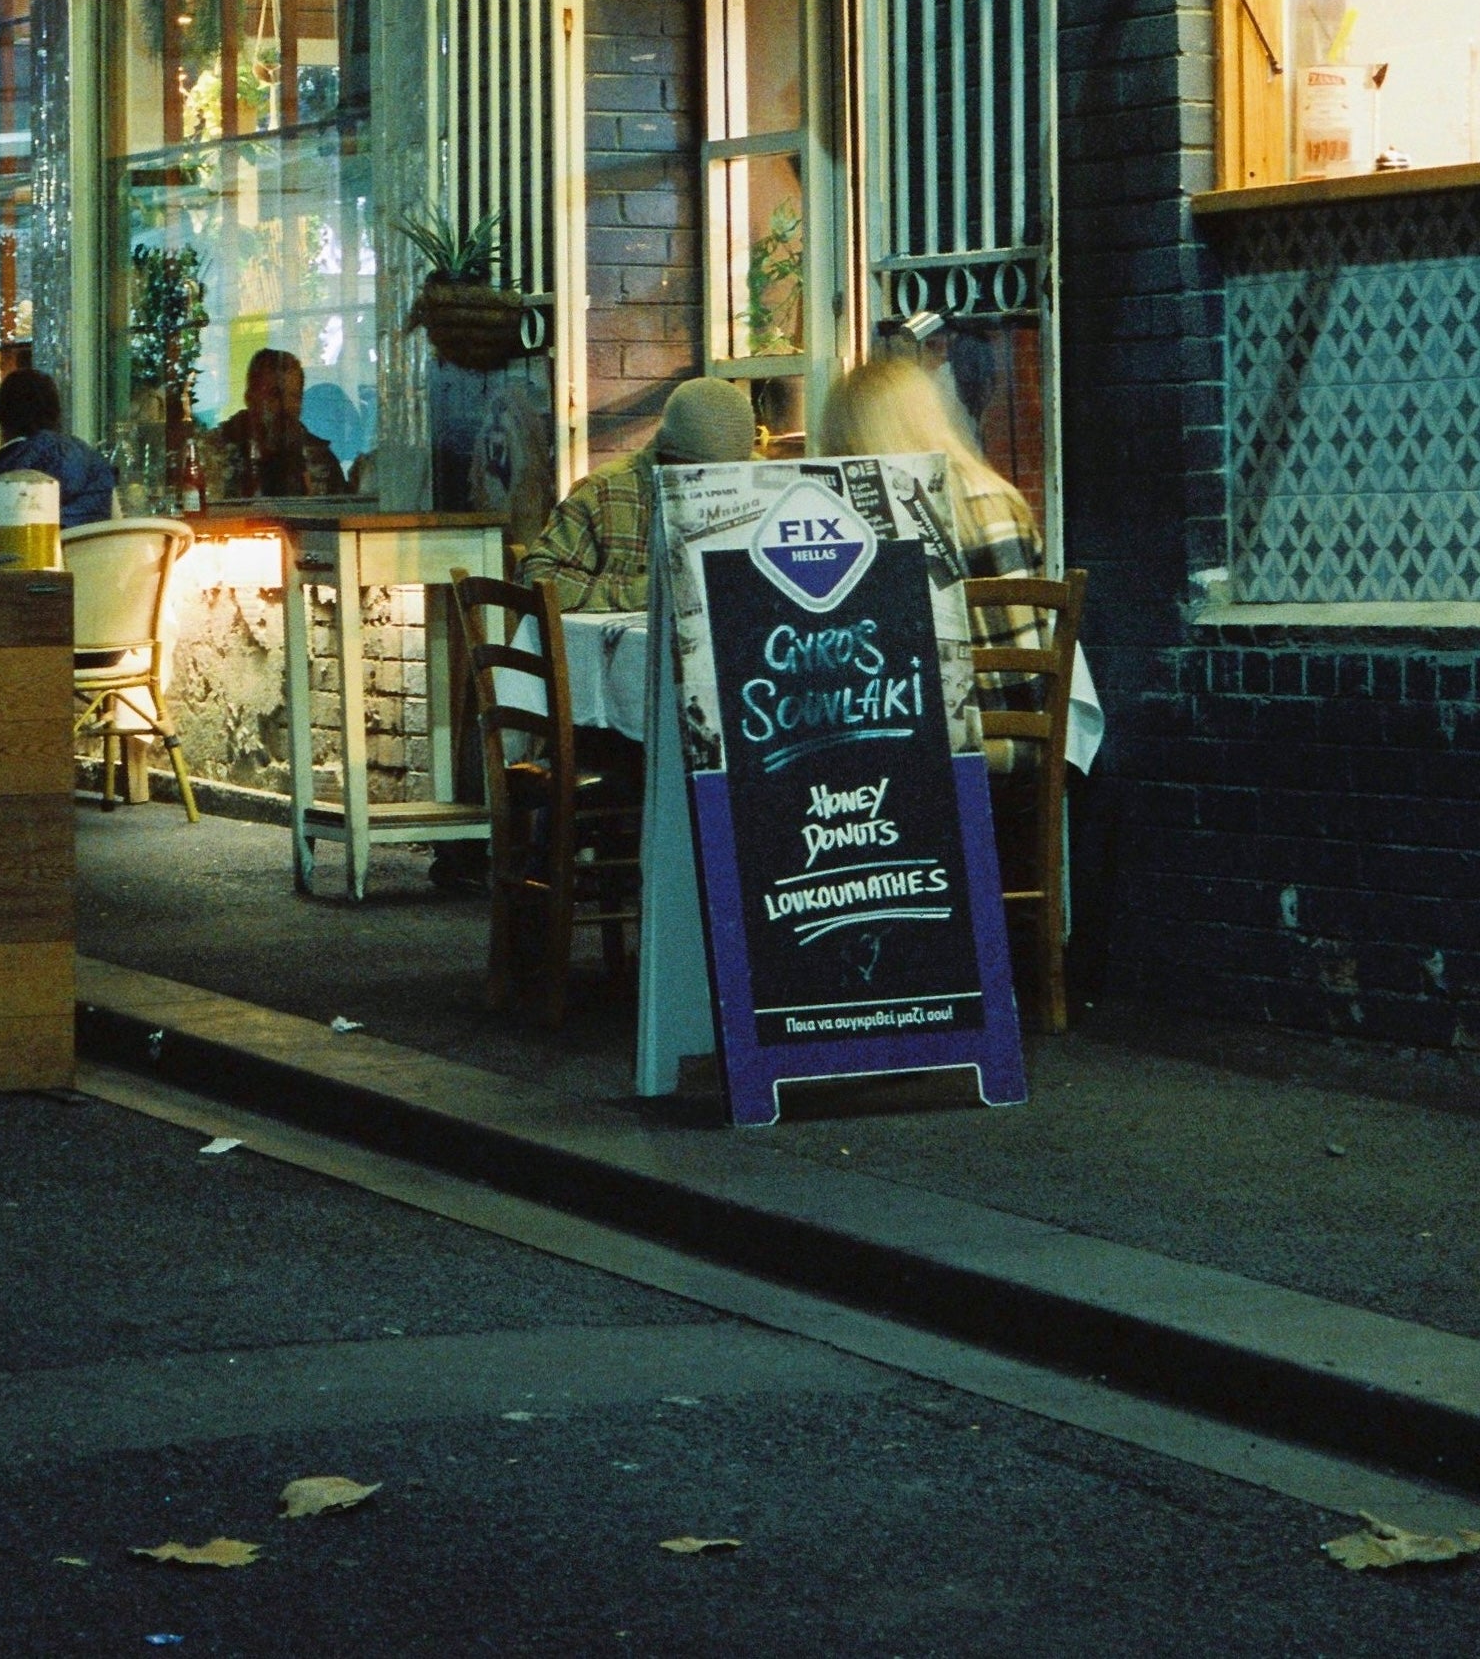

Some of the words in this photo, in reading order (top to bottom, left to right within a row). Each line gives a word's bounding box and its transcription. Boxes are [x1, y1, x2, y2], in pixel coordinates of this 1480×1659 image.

[778, 517, 845, 543] FIX
[791, 547, 838, 562] HELLAS
[764, 619, 885, 675] GYROS
[805, 777, 890, 820] HONEY
[801, 819, 900, 869] DONUTS
[764, 868, 950, 921] LOUKOUMATHES
[785, 1017, 816, 1033] Ποια
[819, 1019, 834, 1031] να
